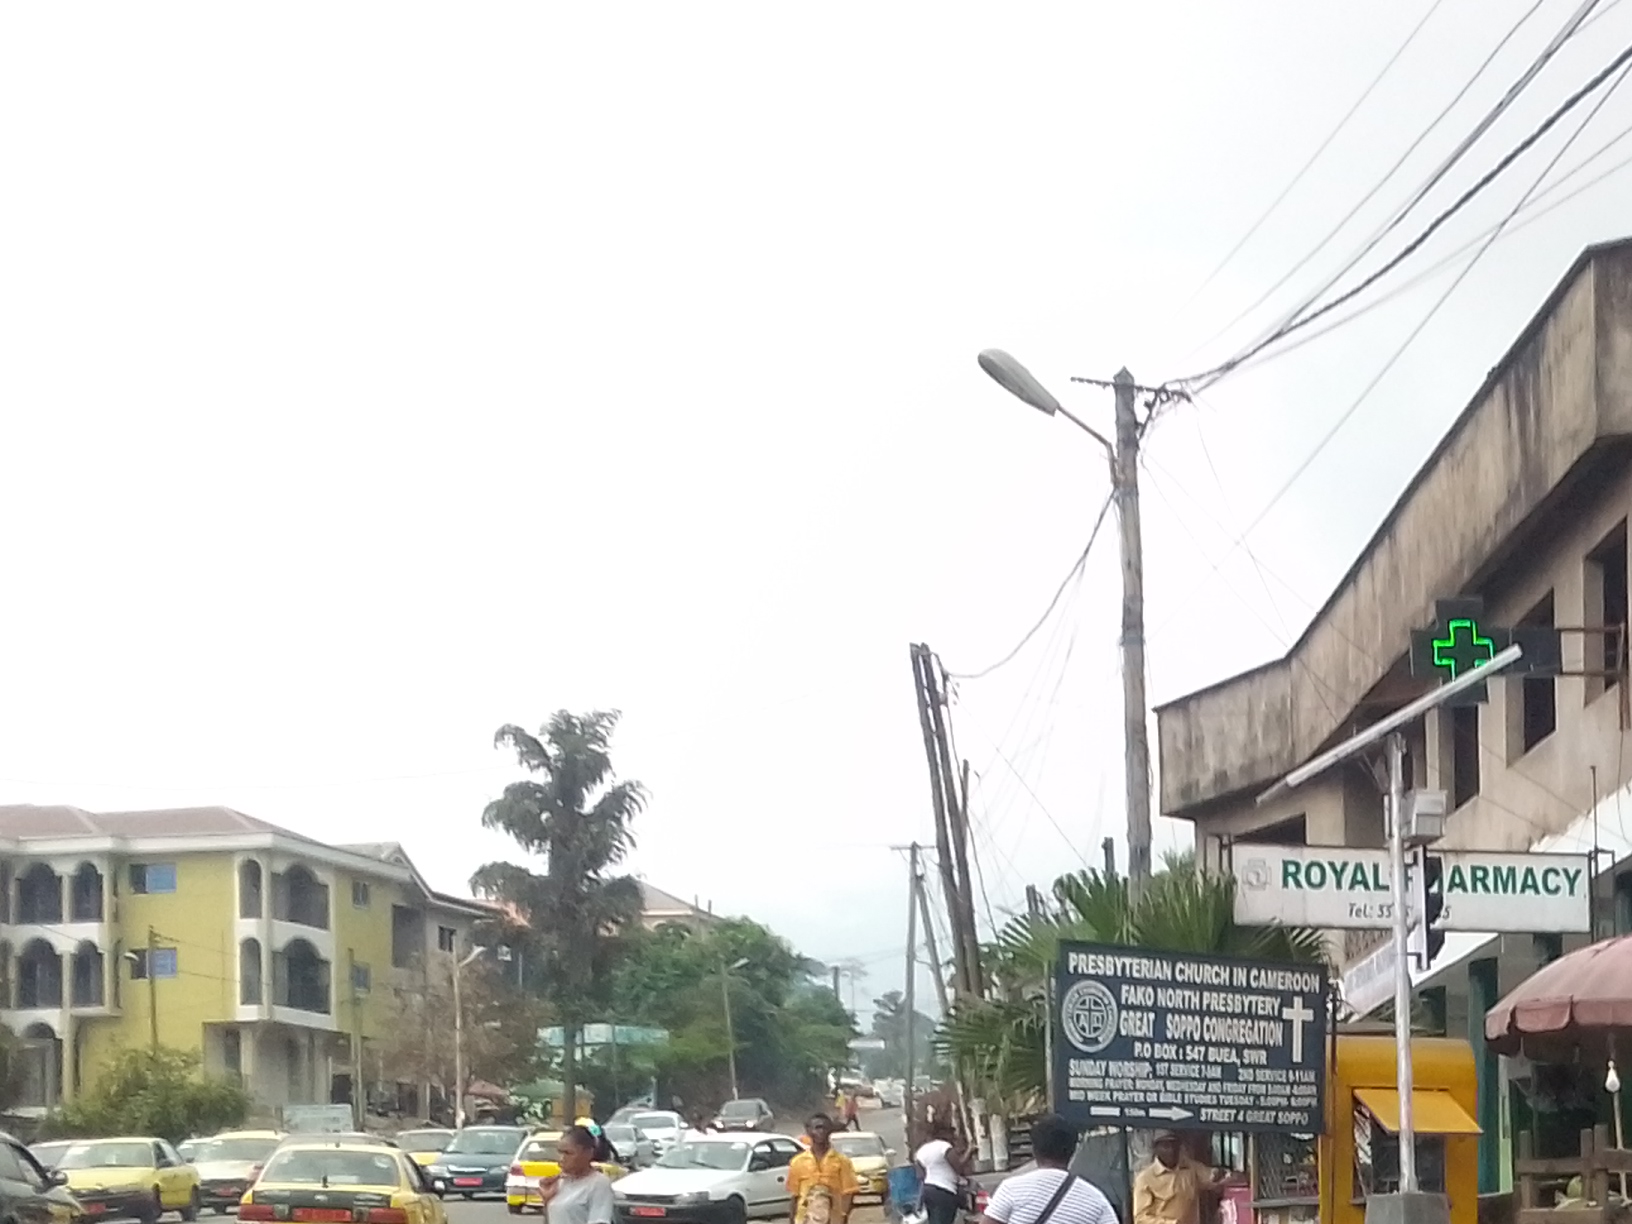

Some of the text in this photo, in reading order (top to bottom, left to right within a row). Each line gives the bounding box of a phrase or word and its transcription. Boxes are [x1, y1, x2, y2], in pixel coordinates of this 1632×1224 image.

[1282, 859, 1390, 892] ROYAL
[1349, 902, 1372, 918] Tel:
[1068, 952, 1320, 994] PRESBYTERIAN CHURCH IN CAMEROON
[1121, 984, 1281, 1017] FAKO NORTH PRESBYTERY
[1120, 1009, 1155, 1039] GREAT
[1166, 1013, 1201, 1041] SOPPO
[1203, 1015, 1283, 1047] CONGREGATION
[1134, 1041, 1152, 1058] P.O
[1154, 1043, 1178, 1060] BOX
[1186, 1045, 1206, 1062] 547
[1208, 1046, 1240, 1067] BUEA,
[1243, 1049, 1267, 1065] SWR
[1069, 1058, 1106, 1076] SUNDAY
[1170, 1064, 1200, 1078] SERVICE
[1256, 1069, 1287, 1083] SERVICE
[1087, 1090, 1111, 1102] WEEK
[1112, 1091, 1145, 1102] PRAYER
[1160, 1092, 1182, 1104] BIBLE
[1184, 1093, 1217, 1105] STUDIES
[1219, 1094, 1254, 1106] TUESDAY
[1200, 1108, 1237, 1122] STREET
[1238, 1110, 1244, 1122] 4
[1246, 1110, 1276, 1123] GREAT
[1277, 1111, 1309, 1126] SOPPO
